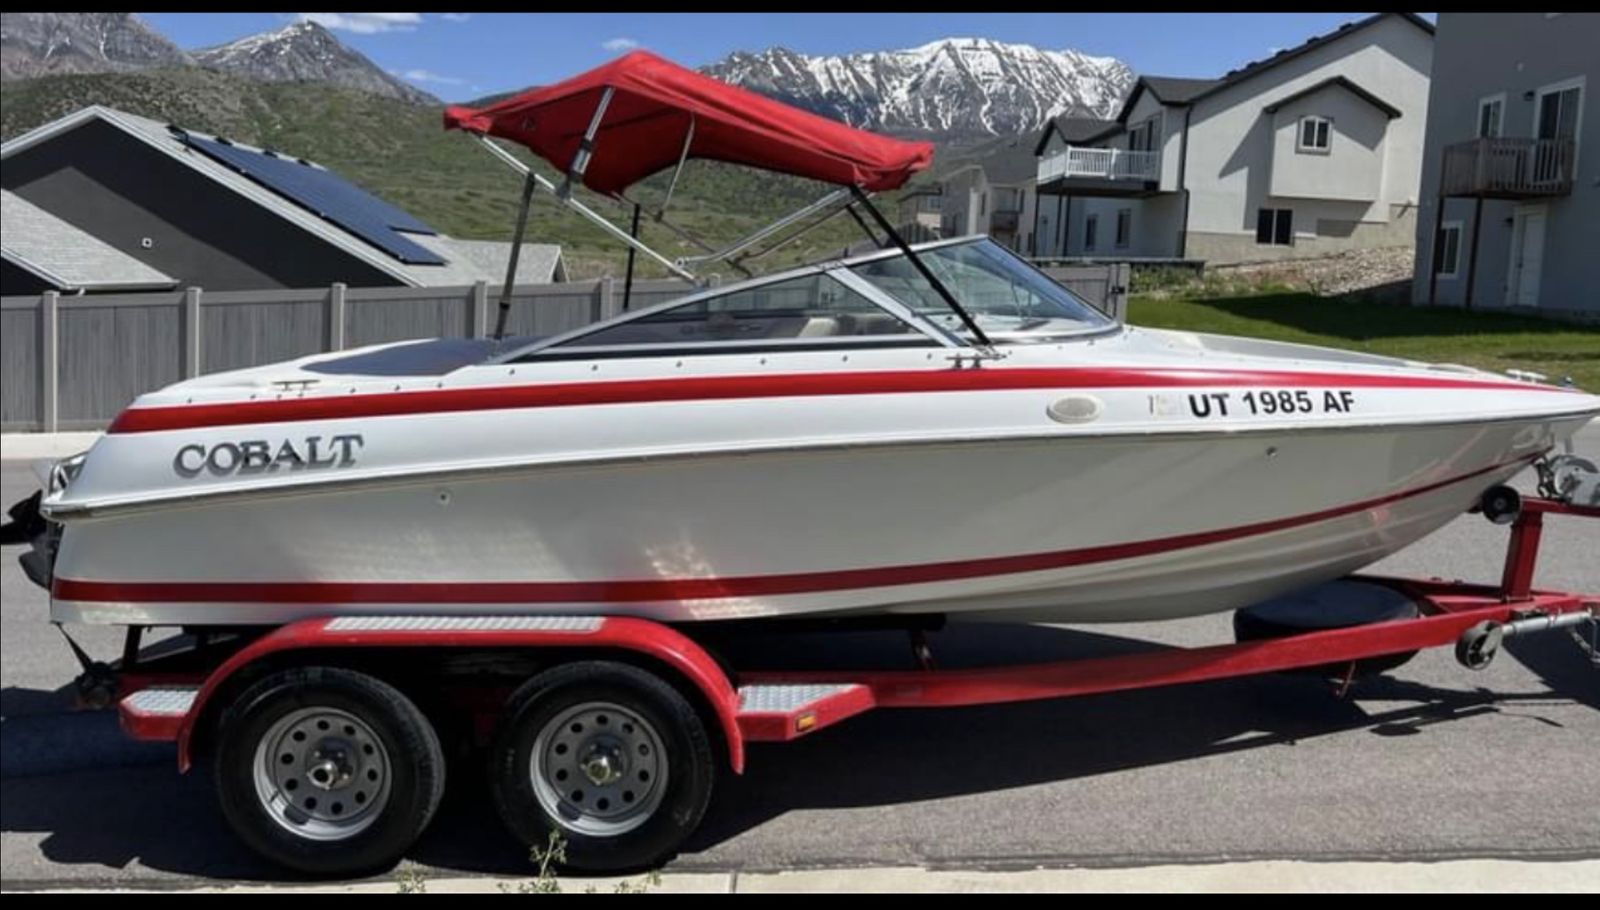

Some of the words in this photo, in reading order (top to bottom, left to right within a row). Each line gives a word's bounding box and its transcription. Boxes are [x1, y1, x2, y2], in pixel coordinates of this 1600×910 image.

[1188, 393, 1229, 418] UT
[1242, 390, 1312, 414] 1985
[1323, 390, 1355, 413] AF
[173, 434, 364, 478] COBALT
